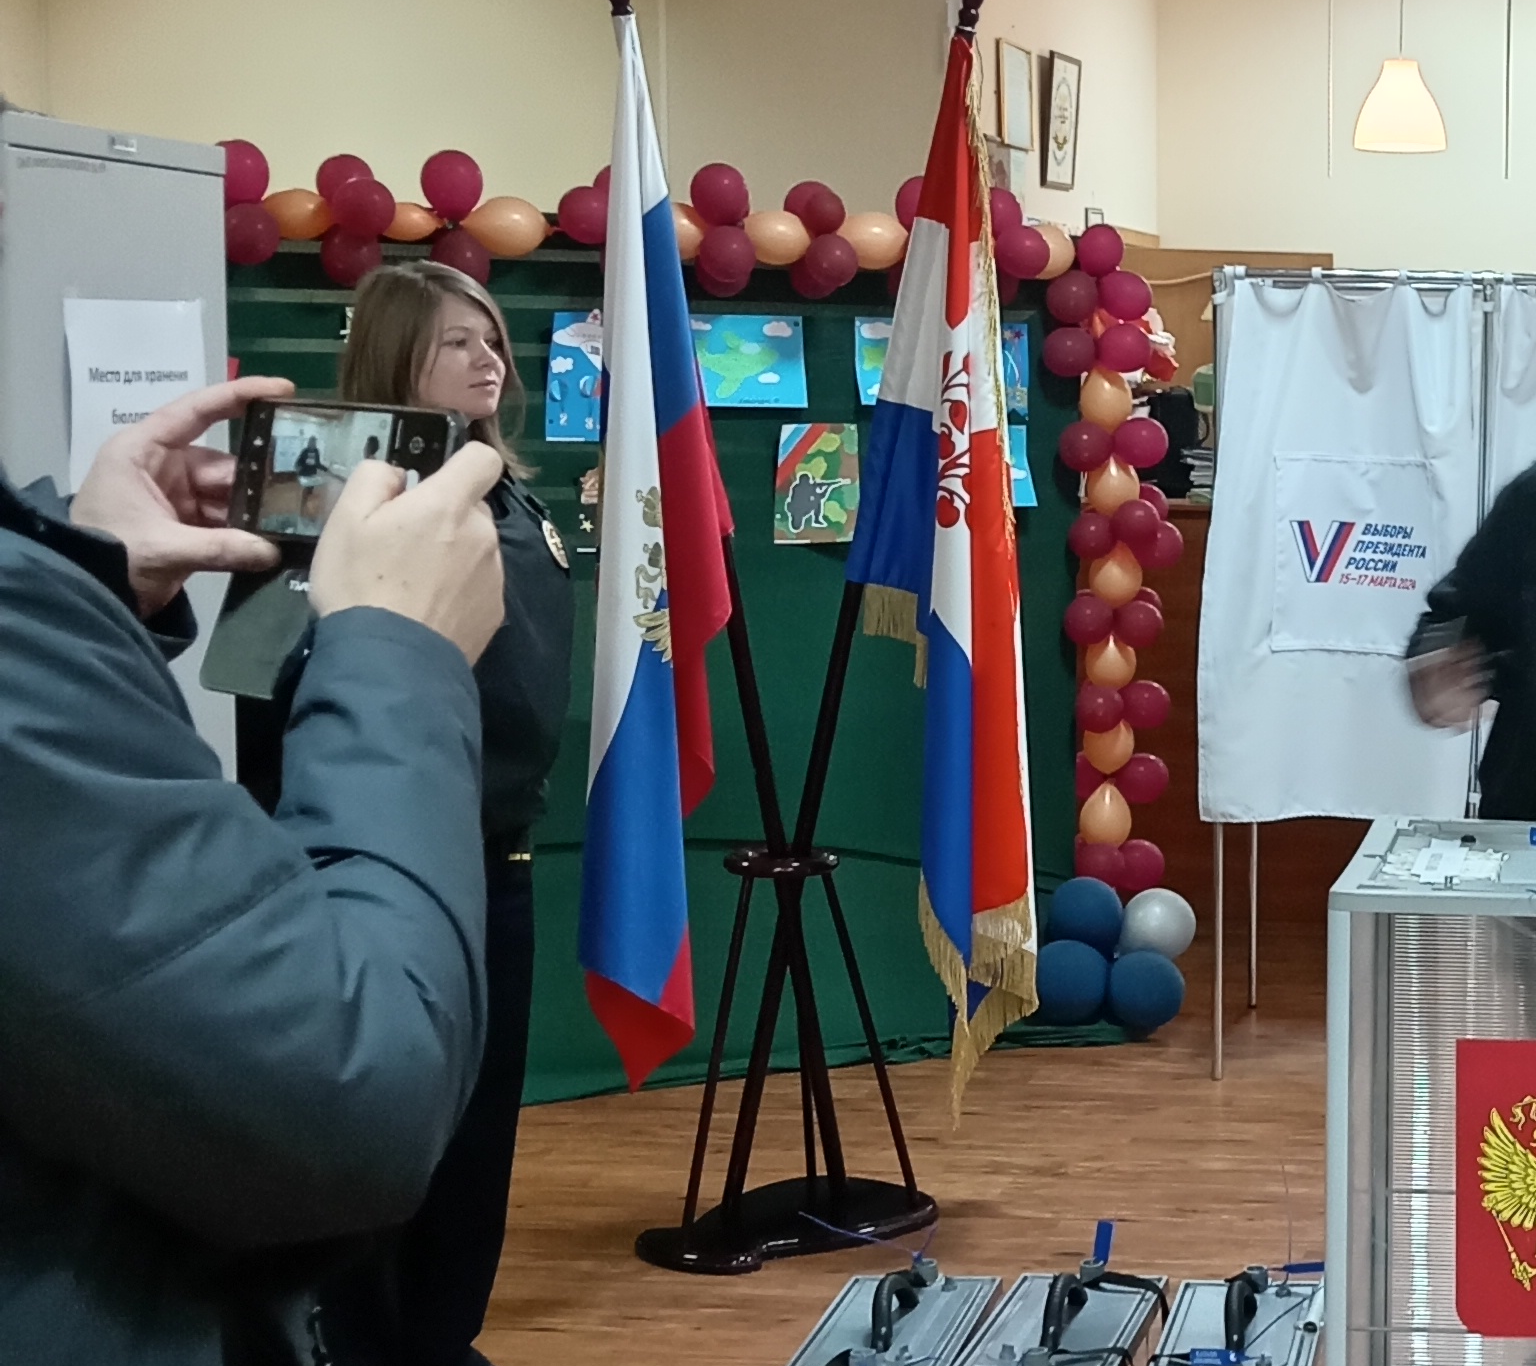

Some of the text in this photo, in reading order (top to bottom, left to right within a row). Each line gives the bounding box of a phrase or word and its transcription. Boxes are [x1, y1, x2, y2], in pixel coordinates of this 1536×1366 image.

[88, 367, 188, 386] Место для хранения
[1361, 523, 1414, 540] ВЫБОРЫ
[1353, 540, 1427, 559] ПРЕЗИДЕНТА
[1344, 556, 1398, 573] РОССИИ
